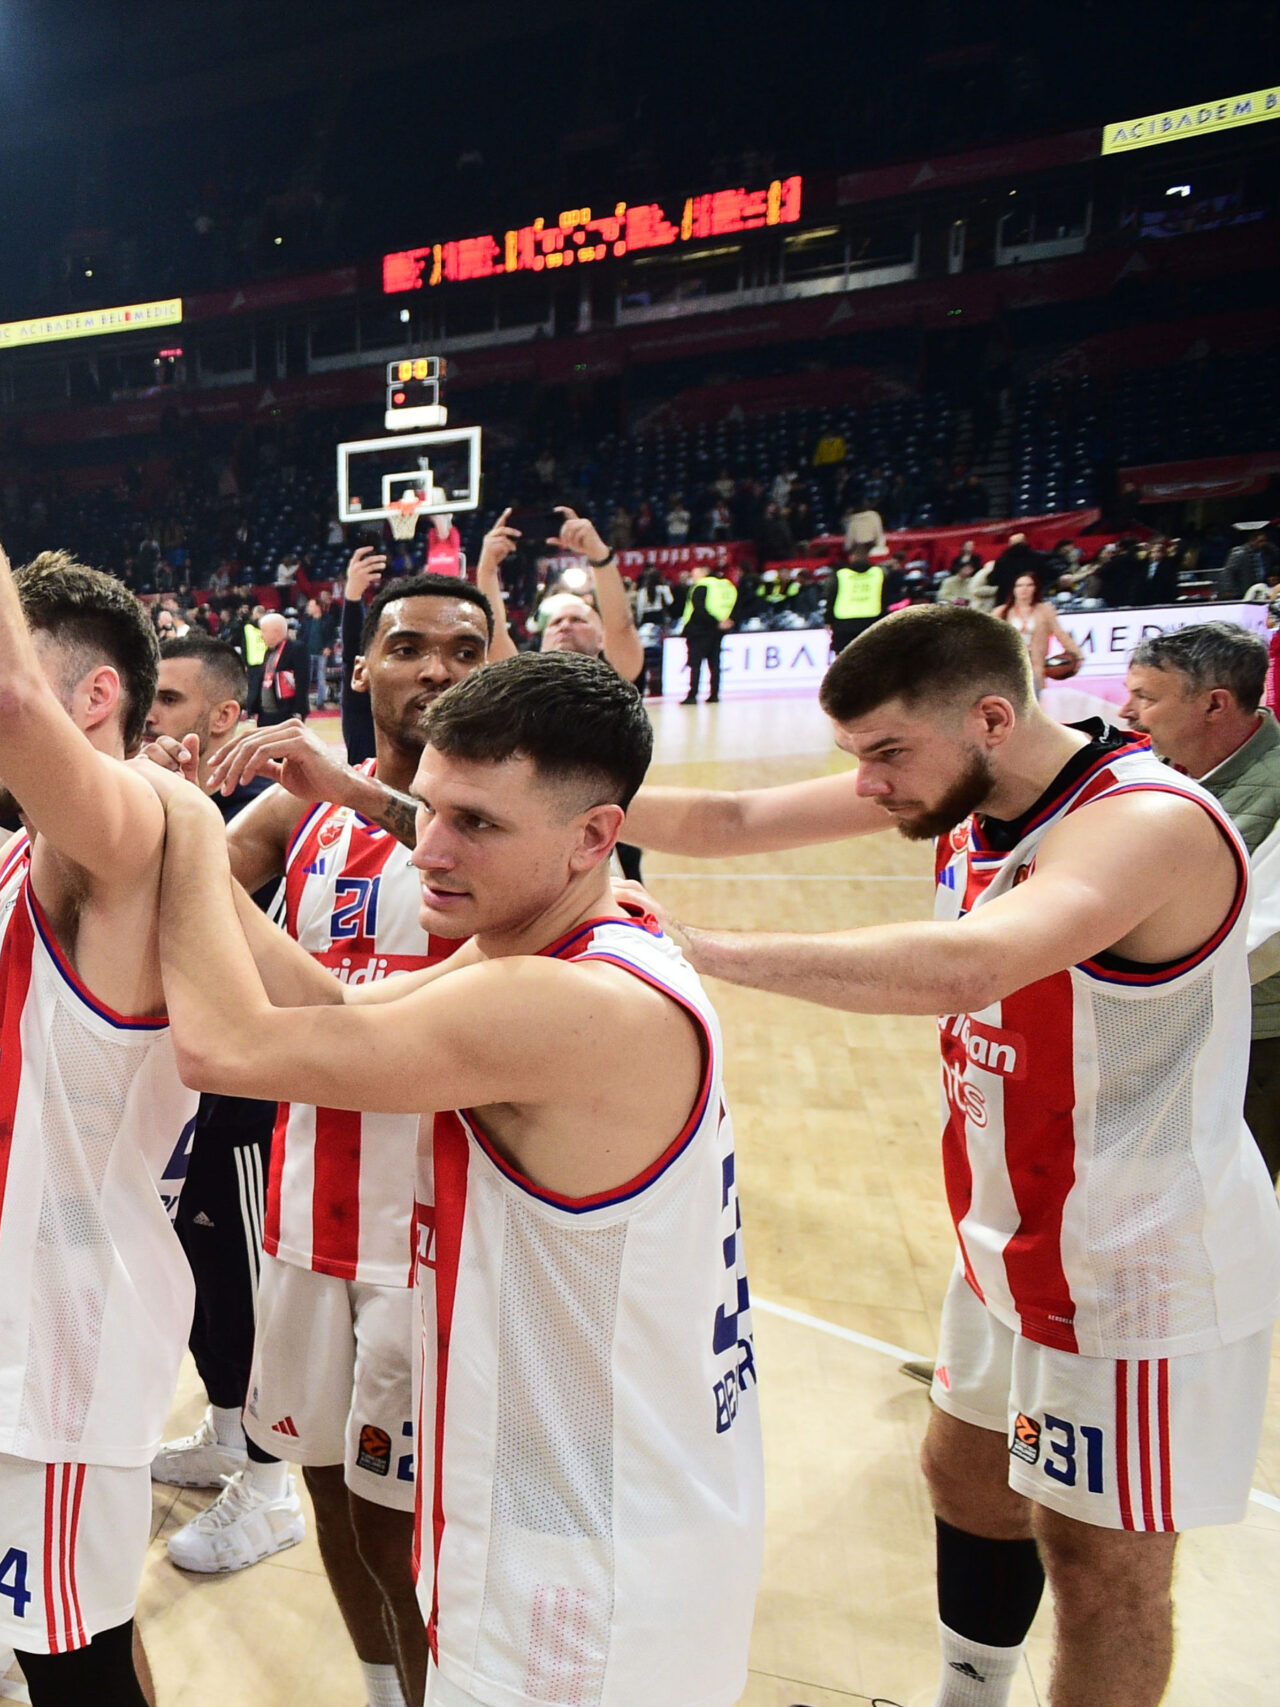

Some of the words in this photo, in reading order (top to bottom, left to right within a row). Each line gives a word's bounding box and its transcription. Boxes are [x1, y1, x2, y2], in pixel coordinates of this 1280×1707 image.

[1111, 100, 1252, 143] ACIBADEM
[330, 874, 381, 938] 21
[1043, 1413, 1105, 1494] 31
